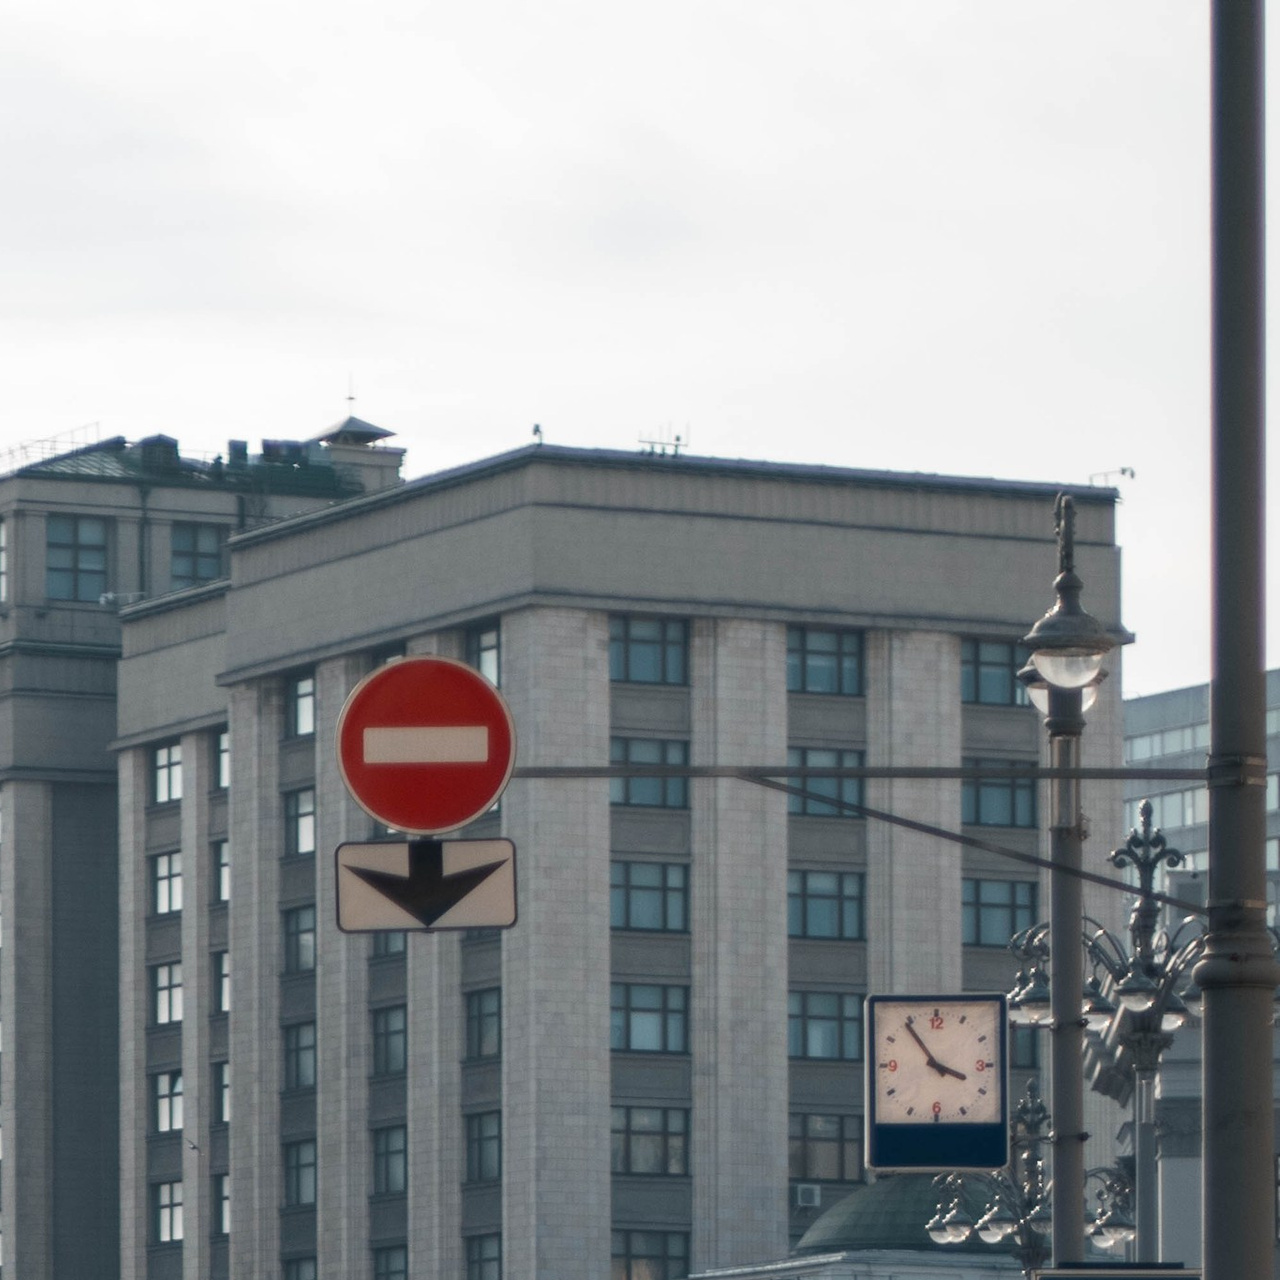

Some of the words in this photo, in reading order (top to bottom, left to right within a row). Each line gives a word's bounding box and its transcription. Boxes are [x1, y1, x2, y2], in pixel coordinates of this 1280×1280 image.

[929, 1018, 943, 1030] 12
[888, 1060, 897, 1072] 9
[976, 1060, 985, 1072] 3
[932, 1102, 941, 1114] 6
